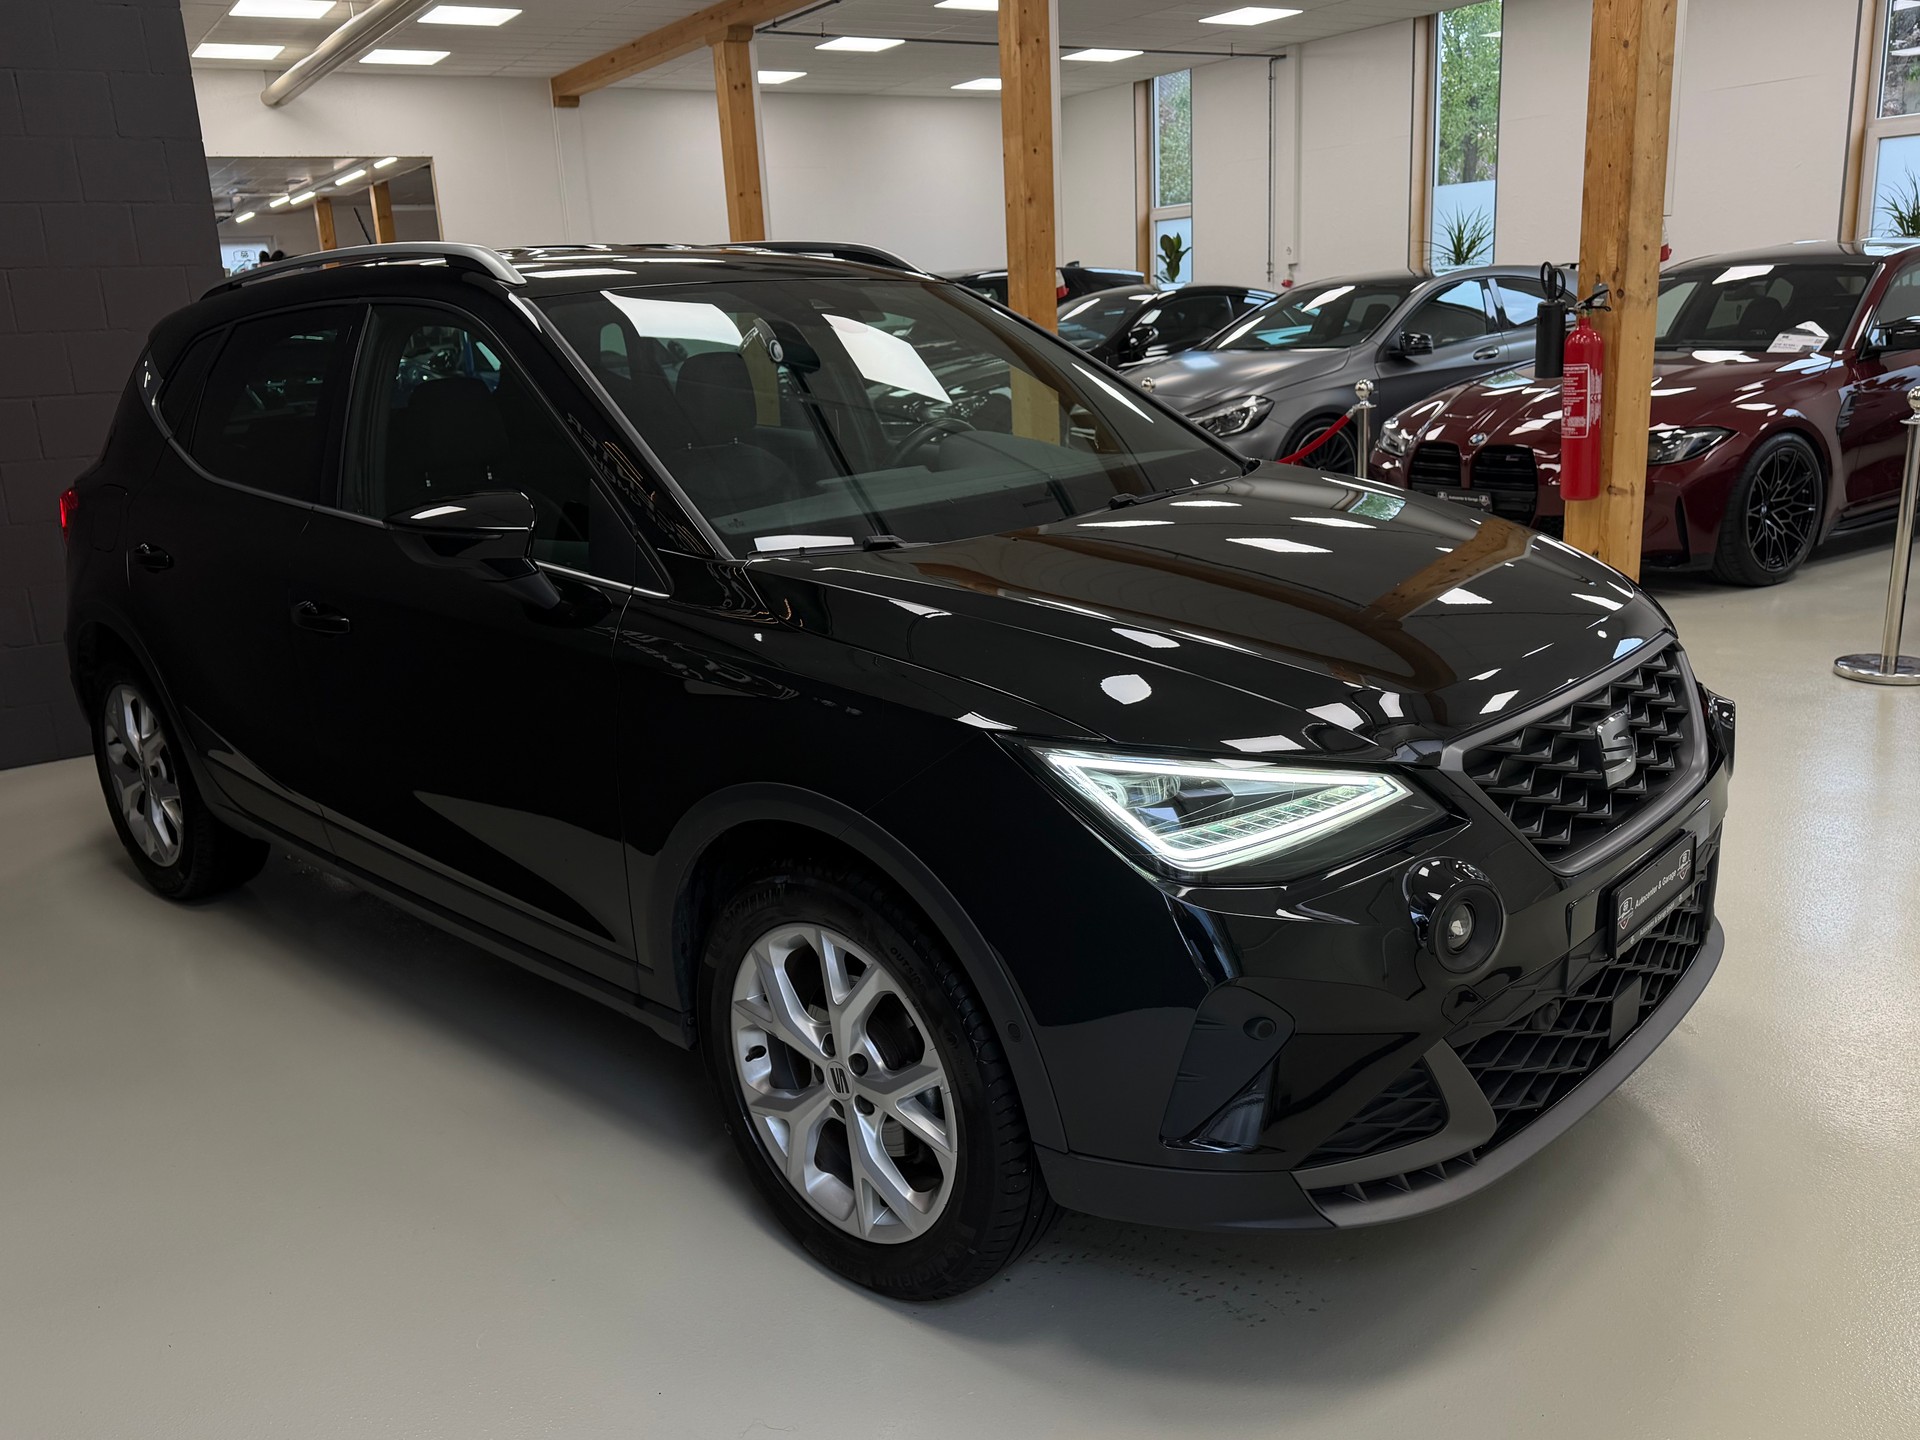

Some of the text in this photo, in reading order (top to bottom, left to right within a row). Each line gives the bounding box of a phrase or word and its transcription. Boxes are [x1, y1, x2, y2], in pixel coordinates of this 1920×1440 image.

[1635, 884, 1658, 910] Autocenter
[1662, 869, 1677, 887] Garage
[890, 947, 926, 992] OUTSIDE
